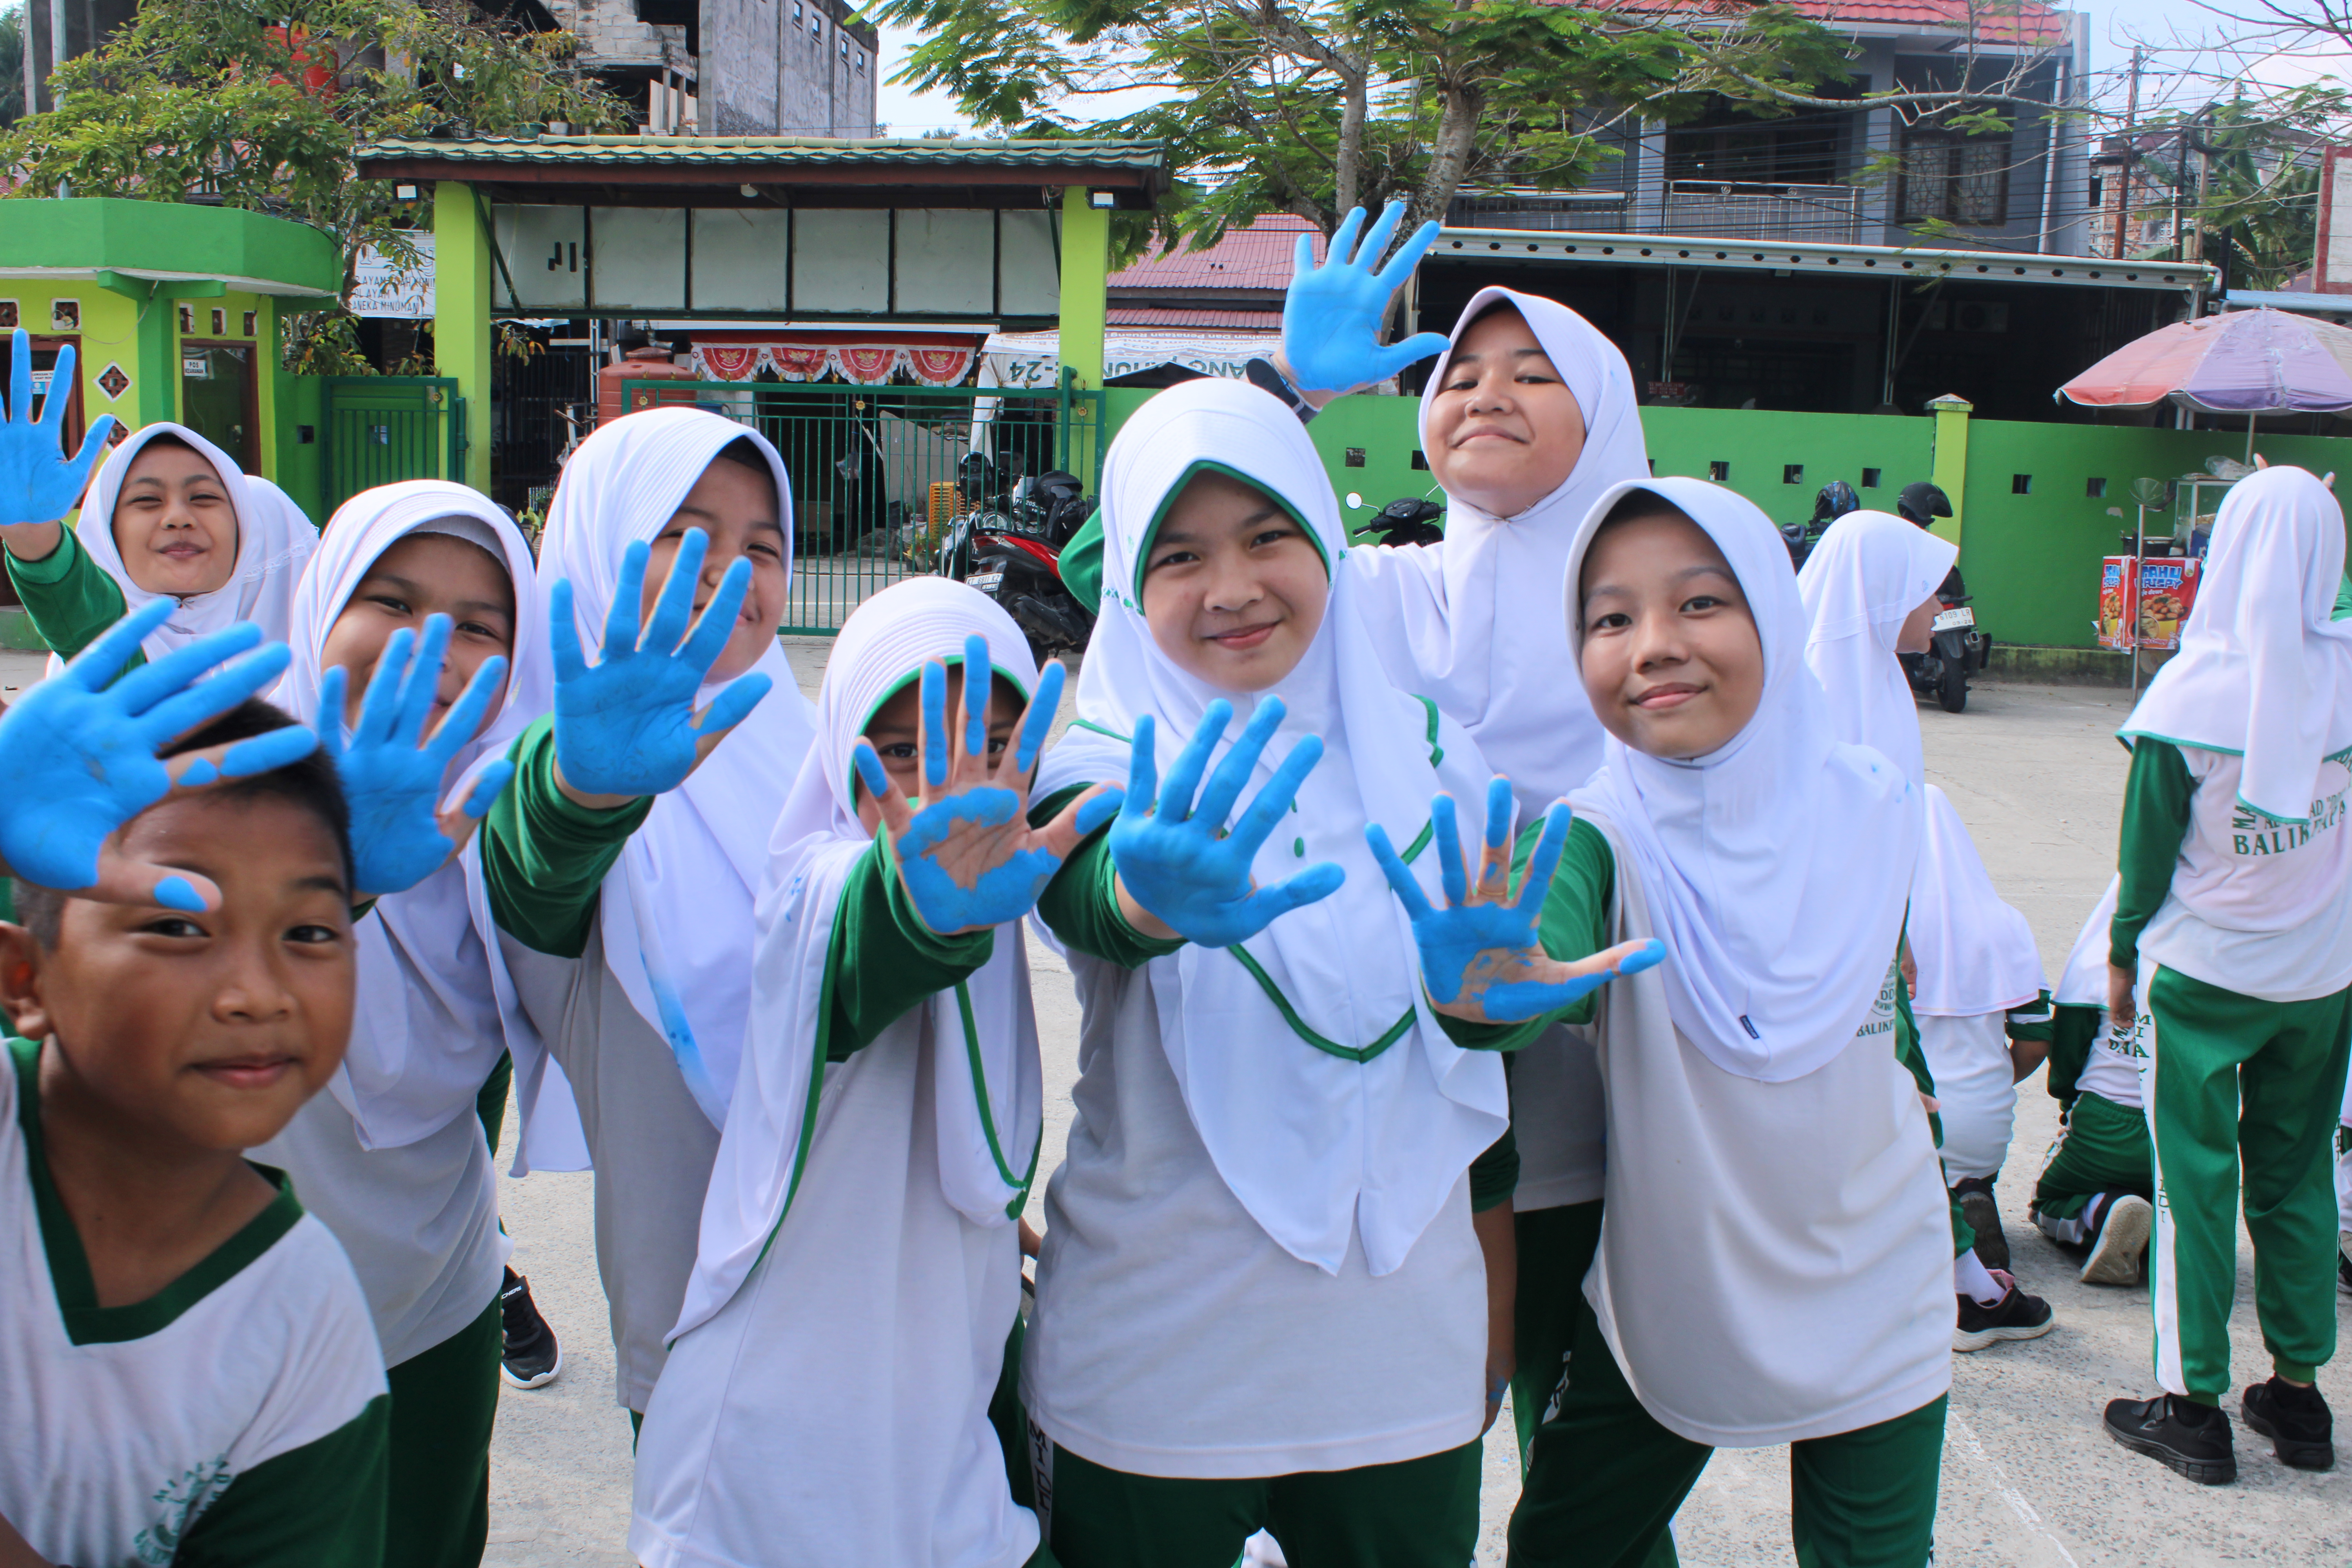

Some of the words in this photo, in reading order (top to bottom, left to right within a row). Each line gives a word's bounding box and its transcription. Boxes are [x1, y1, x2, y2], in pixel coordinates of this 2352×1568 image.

[1009, 361, 1059, 382] -24
[1188, 359, 1247, 379] ANG
[501, 1285, 522, 1299] CHERS
